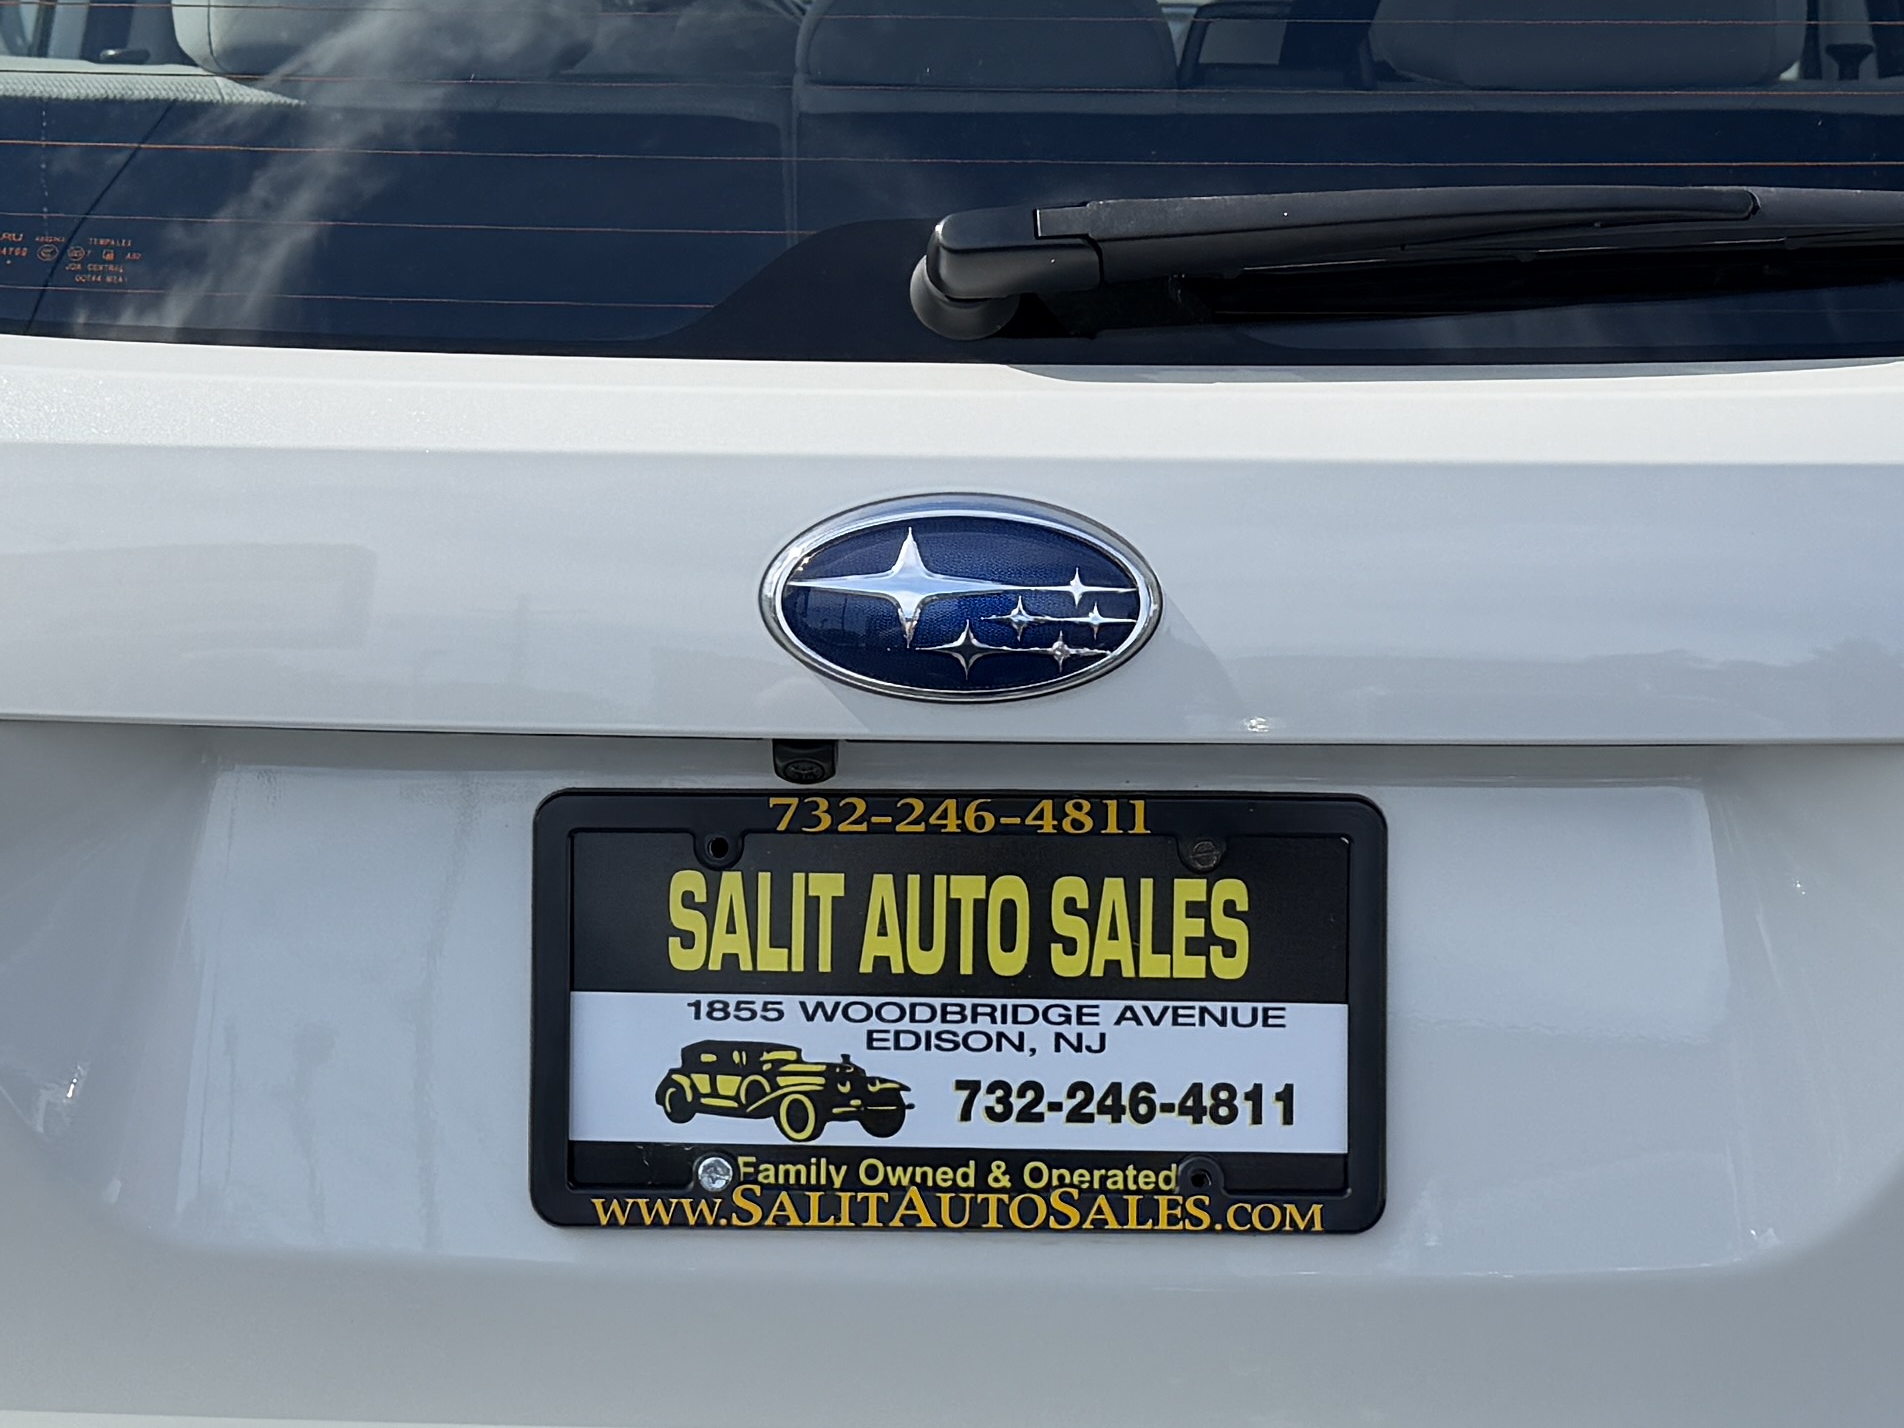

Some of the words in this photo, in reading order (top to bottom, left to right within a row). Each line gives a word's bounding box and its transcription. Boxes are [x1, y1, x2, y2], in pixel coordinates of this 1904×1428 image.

[769, 797, 1152, 834] 732-246-4811
[668, 870, 845, 973] SALIT
[859, 873, 1031, 977] AUTO
[1050, 875, 1249, 980] SALES
[687, 999, 785, 1022] 1855
[799, 1001, 1100, 1026] WOODBRIDGE
[1113, 1005, 1286, 1028] AVENUE
[866, 1029, 1037, 1057] EDISON,
[1054, 1032, 1107, 1053] NJ
[954, 1078, 1295, 1126] 732-246-4811
[737, 1156, 848, 1189] Family
[858, 1158, 976, 1188] Owned
[986, 1161, 1012, 1189] &
[1023, 1161, 1179, 1191] Operated
